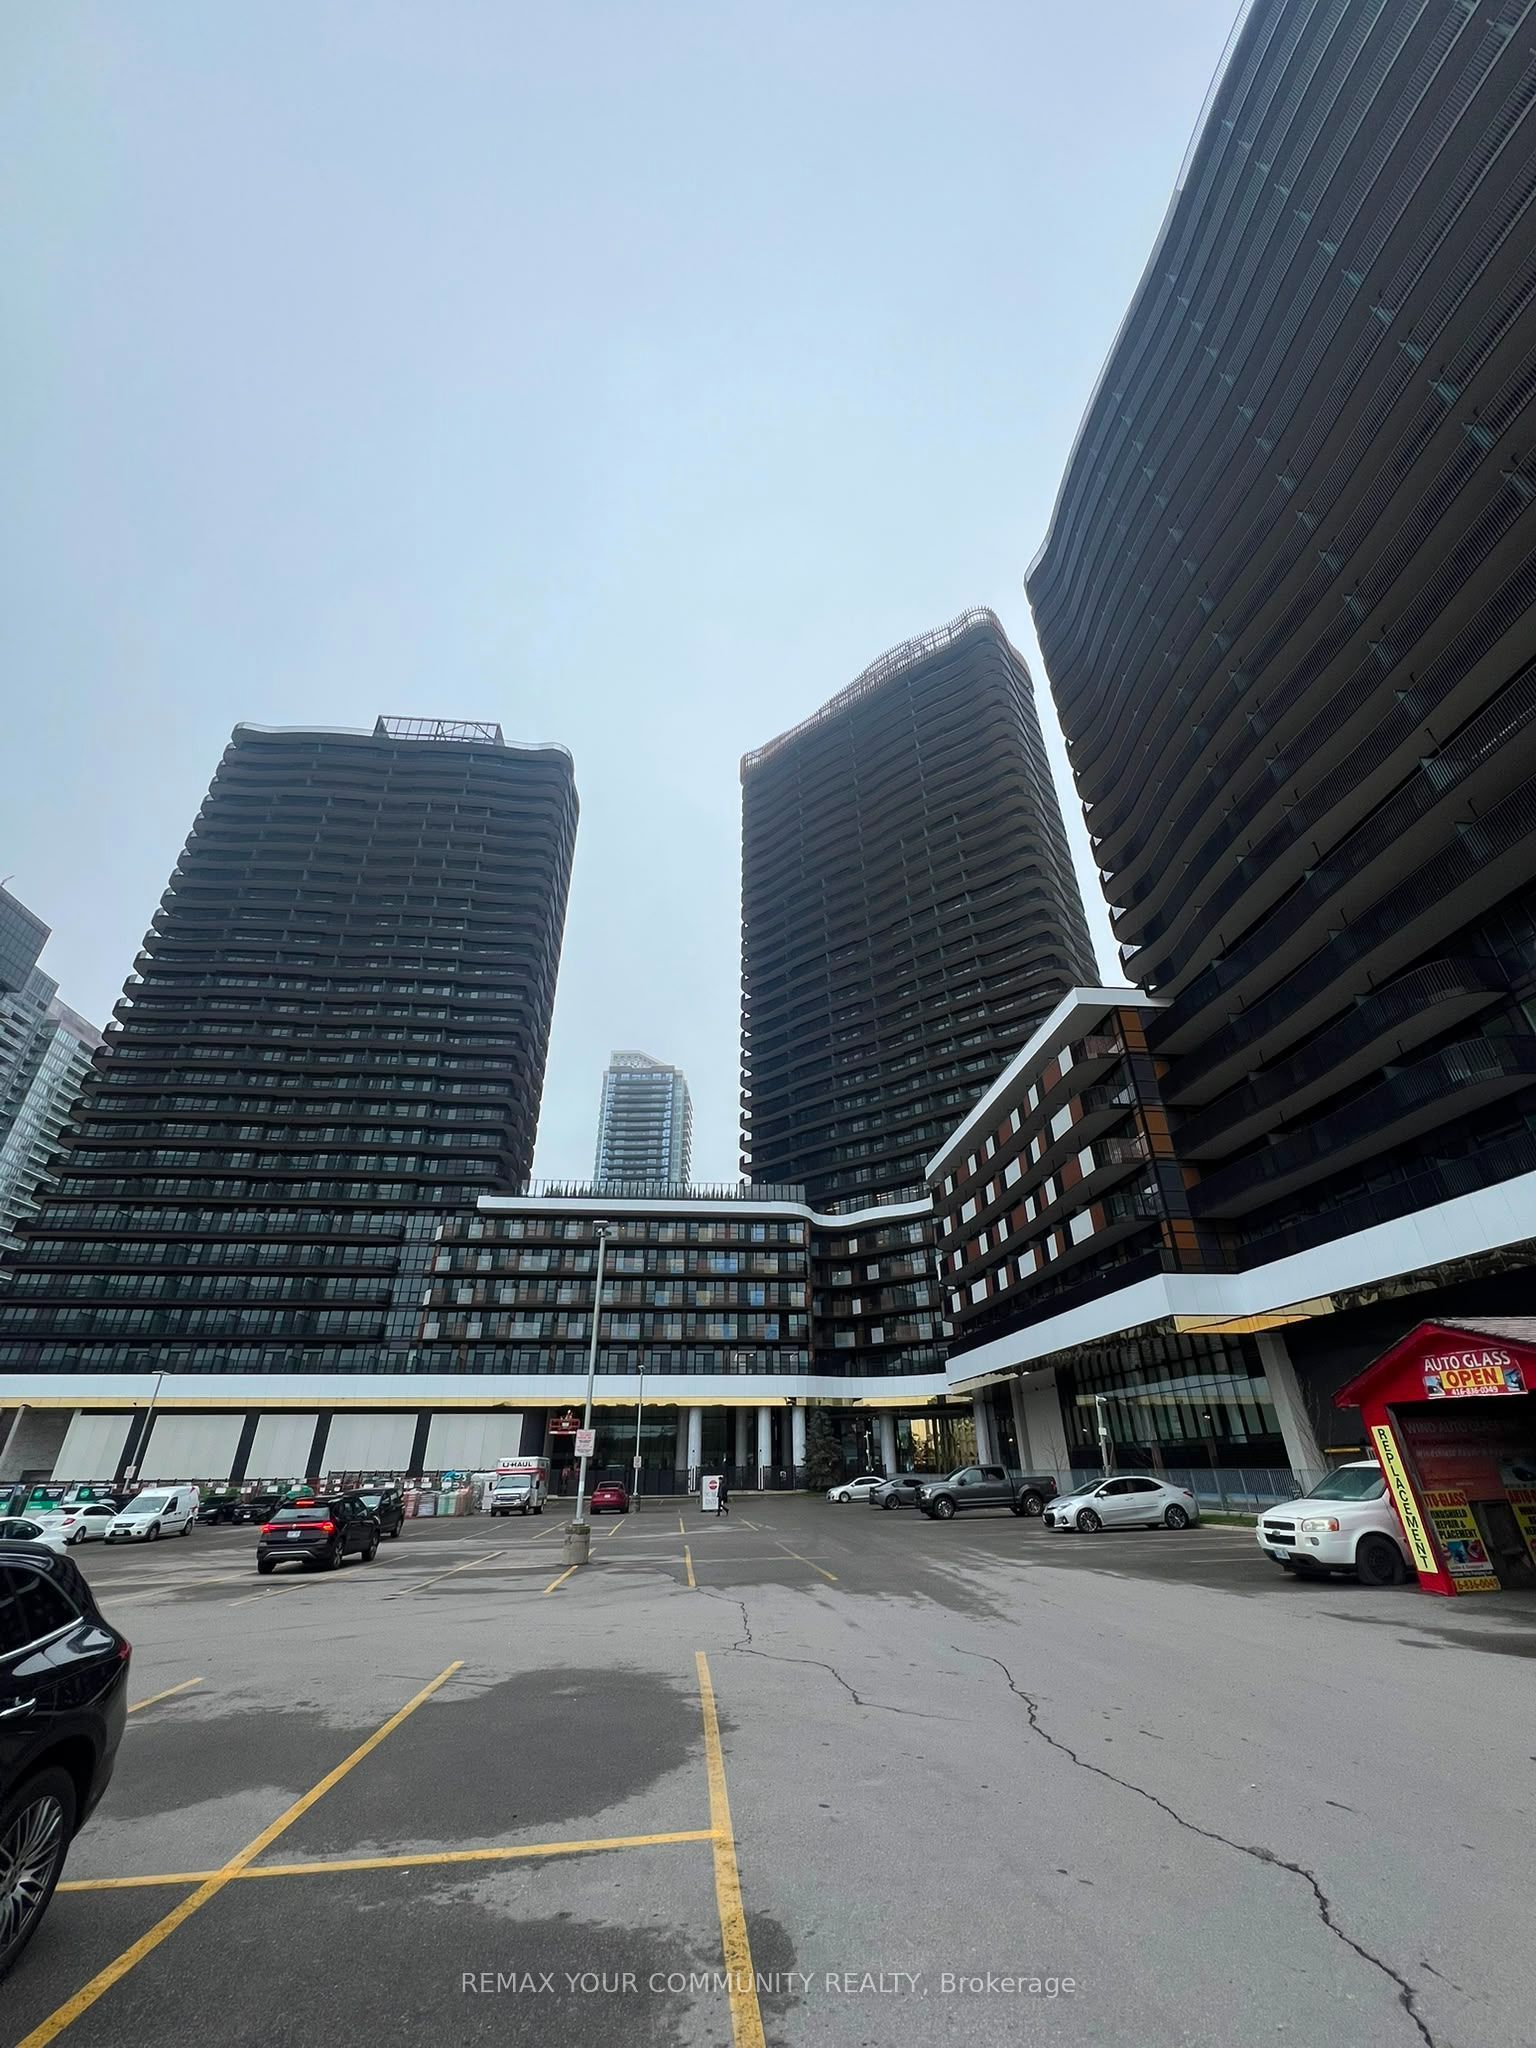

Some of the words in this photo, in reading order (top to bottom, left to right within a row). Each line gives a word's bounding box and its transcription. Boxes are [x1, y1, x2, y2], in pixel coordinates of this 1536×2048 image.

[1424, 1355, 1460, 1372] AUTO
[1462, 1350, 1511, 1368] GLASS
[1445, 1367, 1499, 1387] OPEN
[1377, 1428, 1428, 1569] REPLACEMENT
[1438, 1529, 1478, 1540] PLACEMENT
